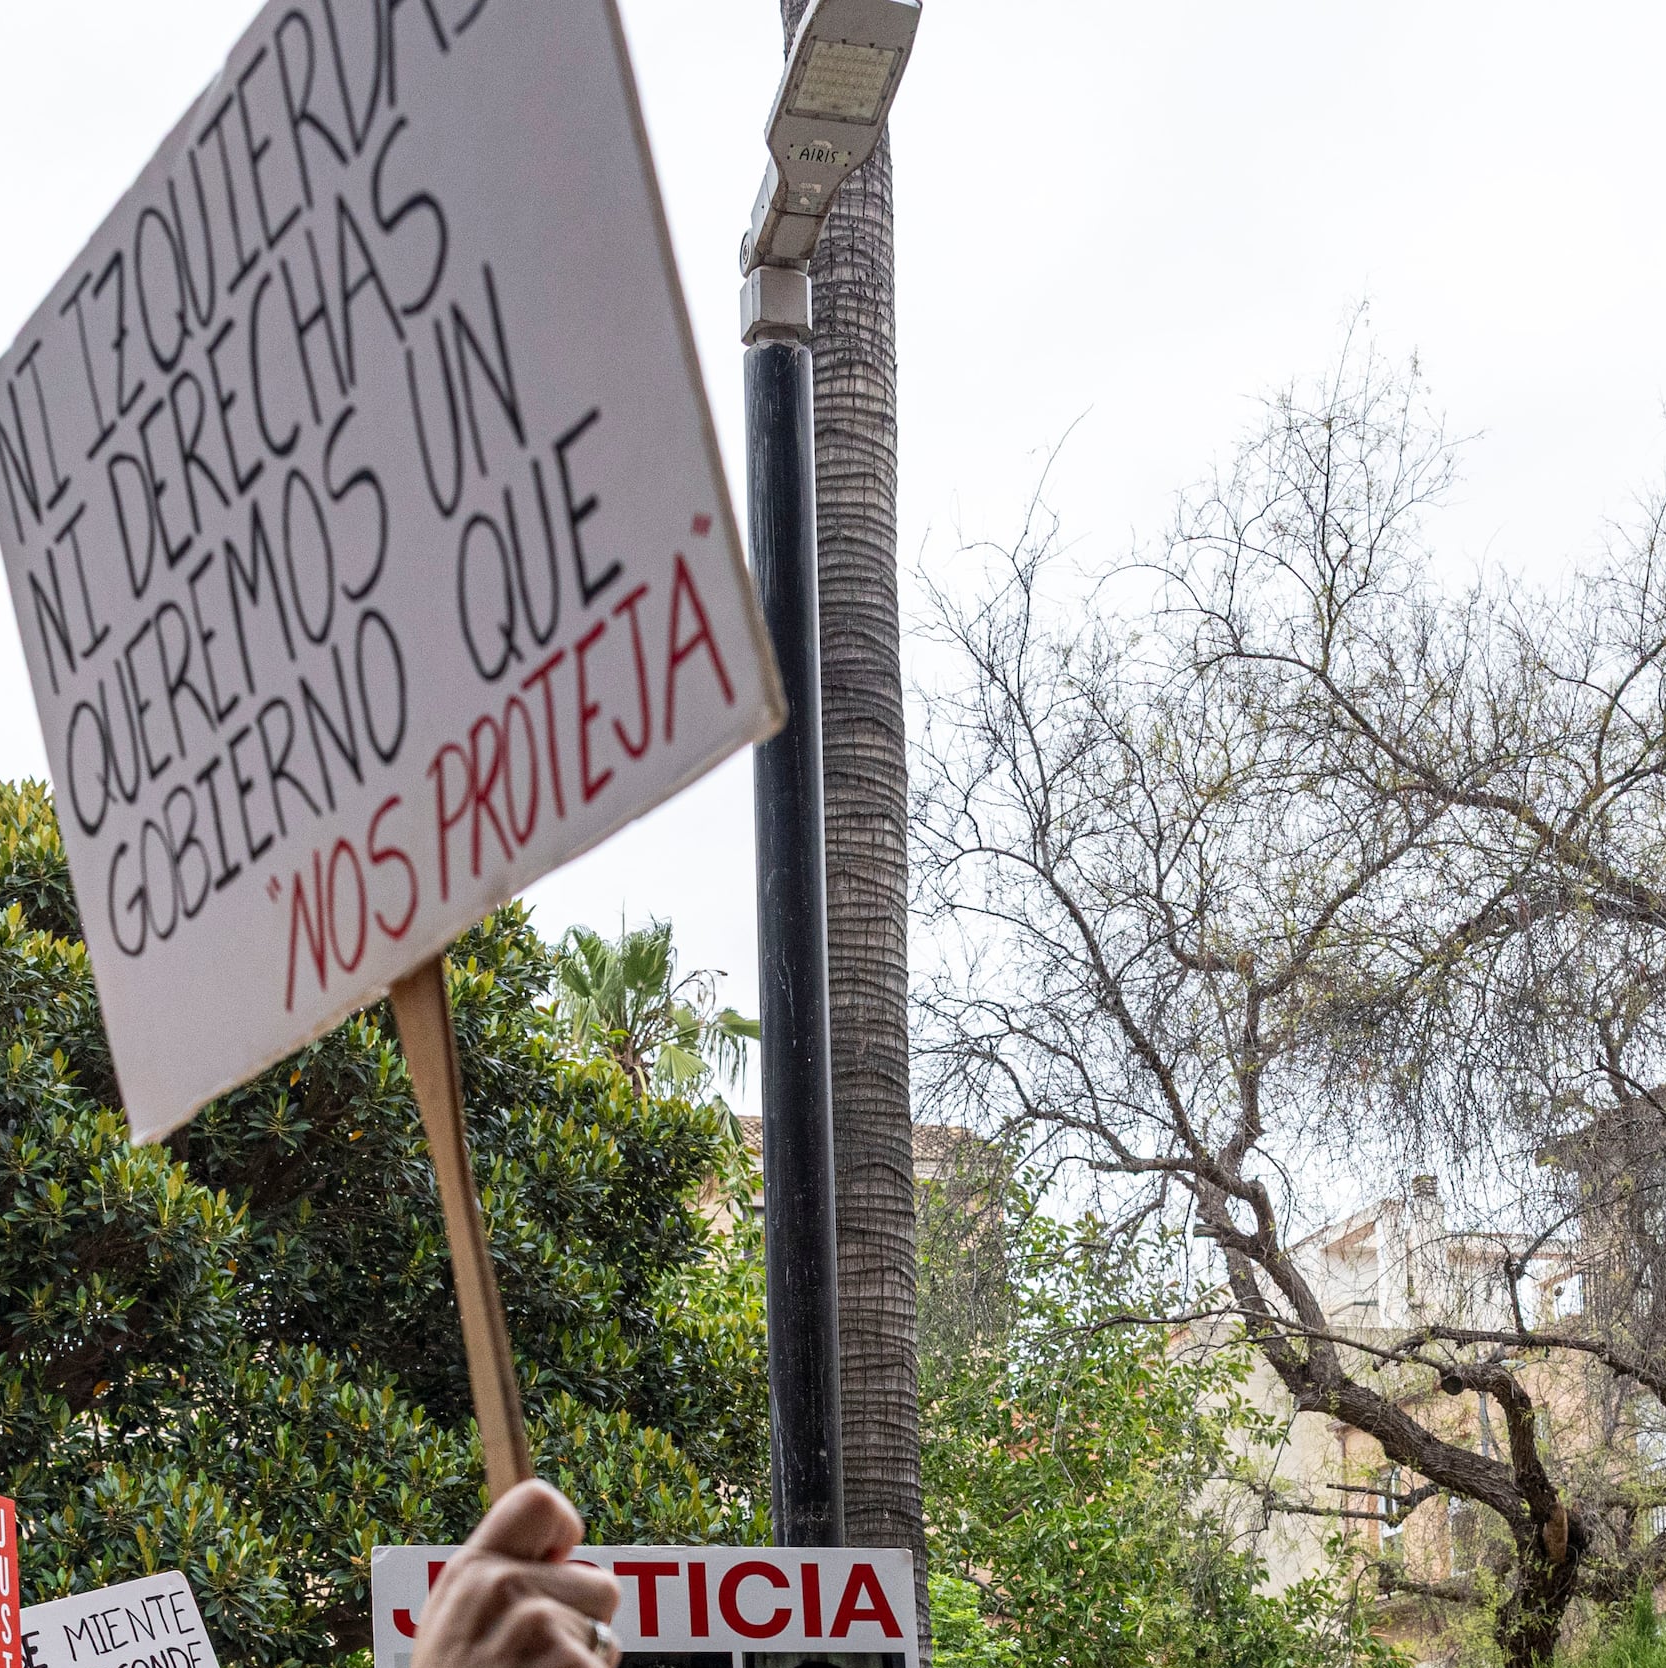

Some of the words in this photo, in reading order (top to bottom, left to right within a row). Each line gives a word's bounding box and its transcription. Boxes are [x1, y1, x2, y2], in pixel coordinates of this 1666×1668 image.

[59, 0, 485, 460] IZQUIERDA
[798, 147, 840, 164] AIRIS
[25, 503, 109, 695] NI
[105, 116, 450, 603] DERECHAS
[64, 406, 391, 839] QUEREMOS
[406, 260, 527, 518] UN
[105, 609, 408, 958] GOBIERNO
[456, 408, 624, 684] QUE
[63, 1591, 195, 1661] MIENTE
[393, 1560, 905, 1638] JTICIA
